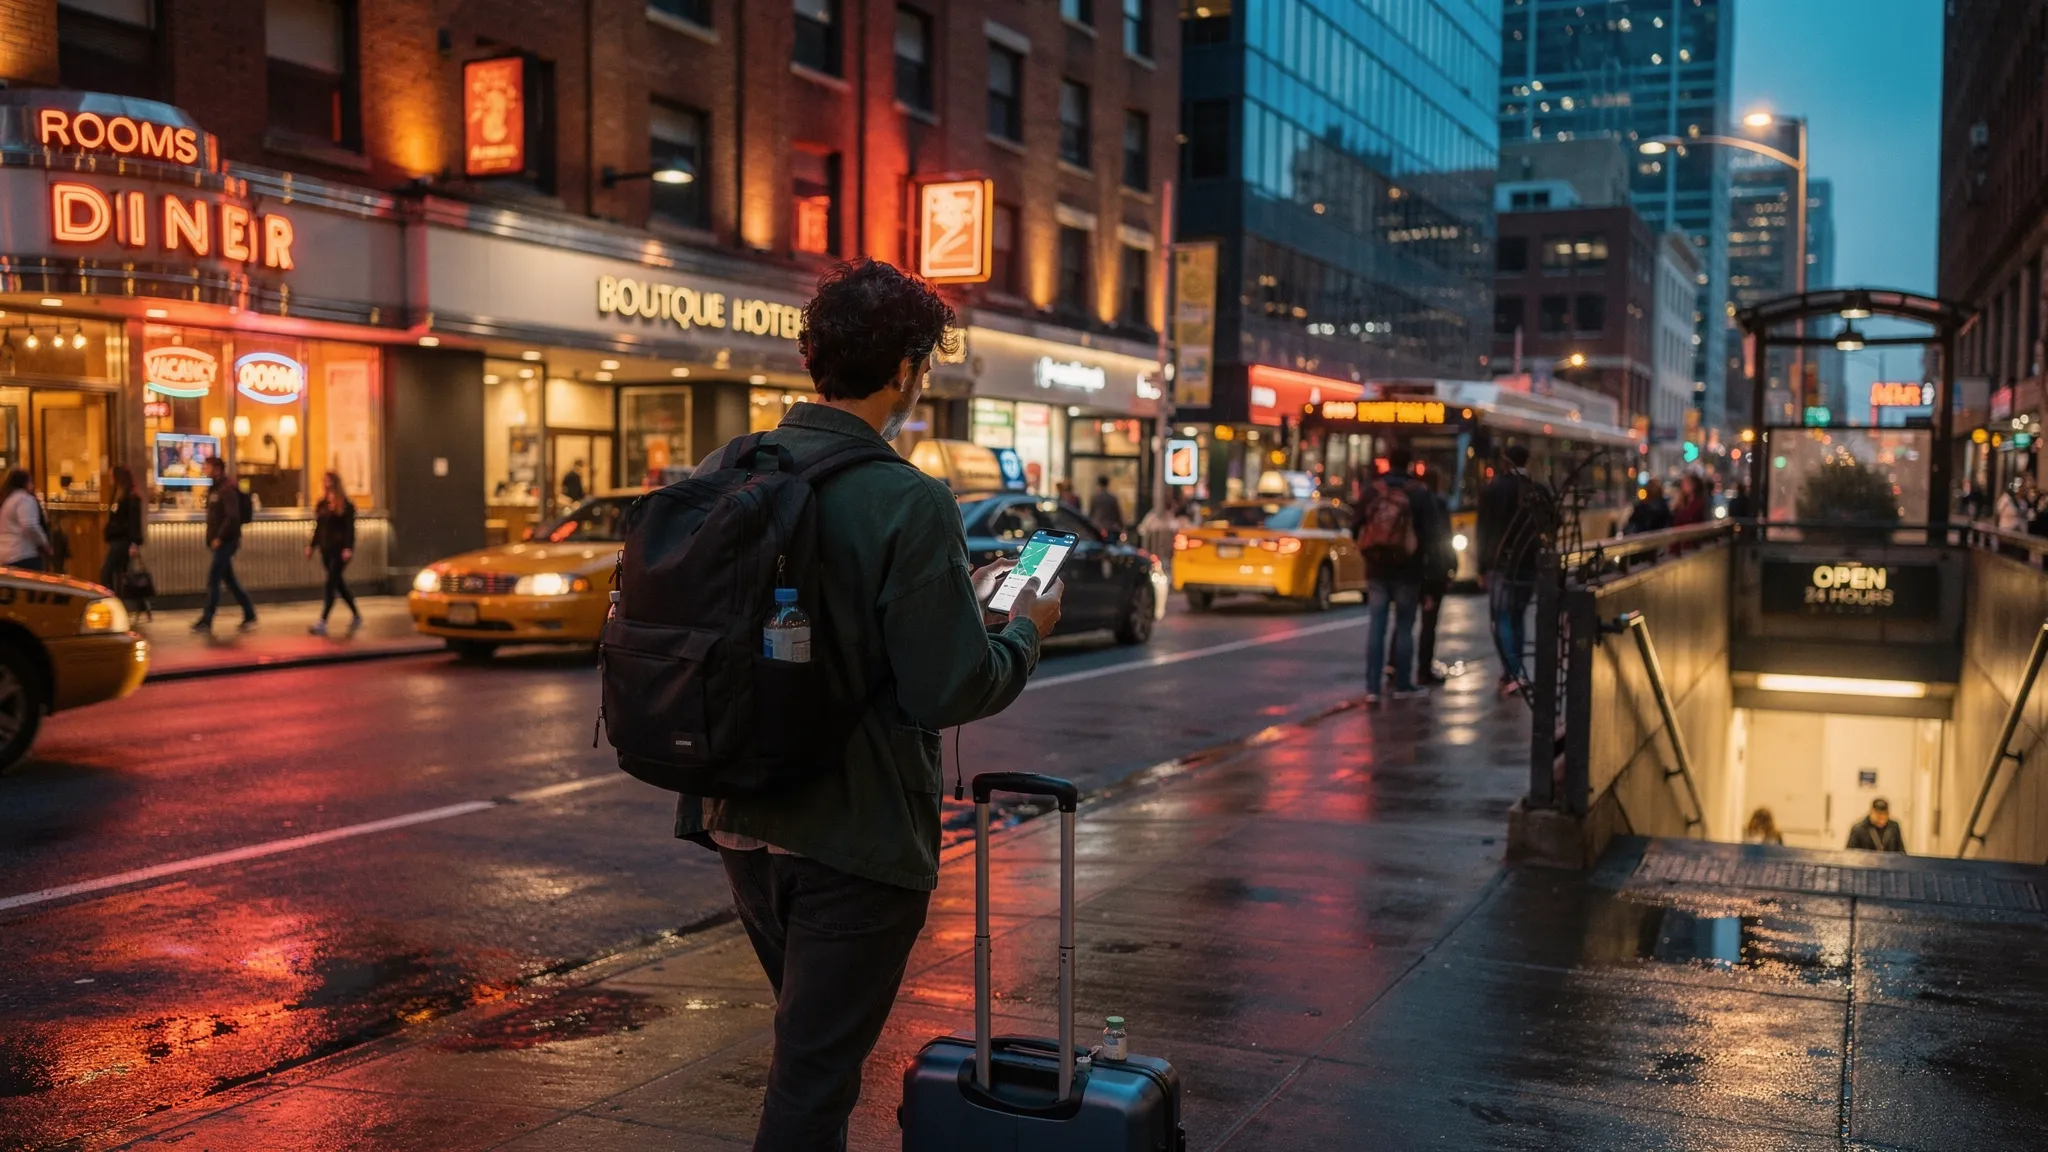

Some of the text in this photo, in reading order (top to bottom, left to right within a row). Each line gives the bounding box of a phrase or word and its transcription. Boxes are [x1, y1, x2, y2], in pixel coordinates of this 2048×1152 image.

[40, 109, 198, 165] ROOMS
[51, 182, 295, 271] DINER
[598, 274, 726, 330] BOUTQUE
[1812, 565, 1887, 590] OPEN
